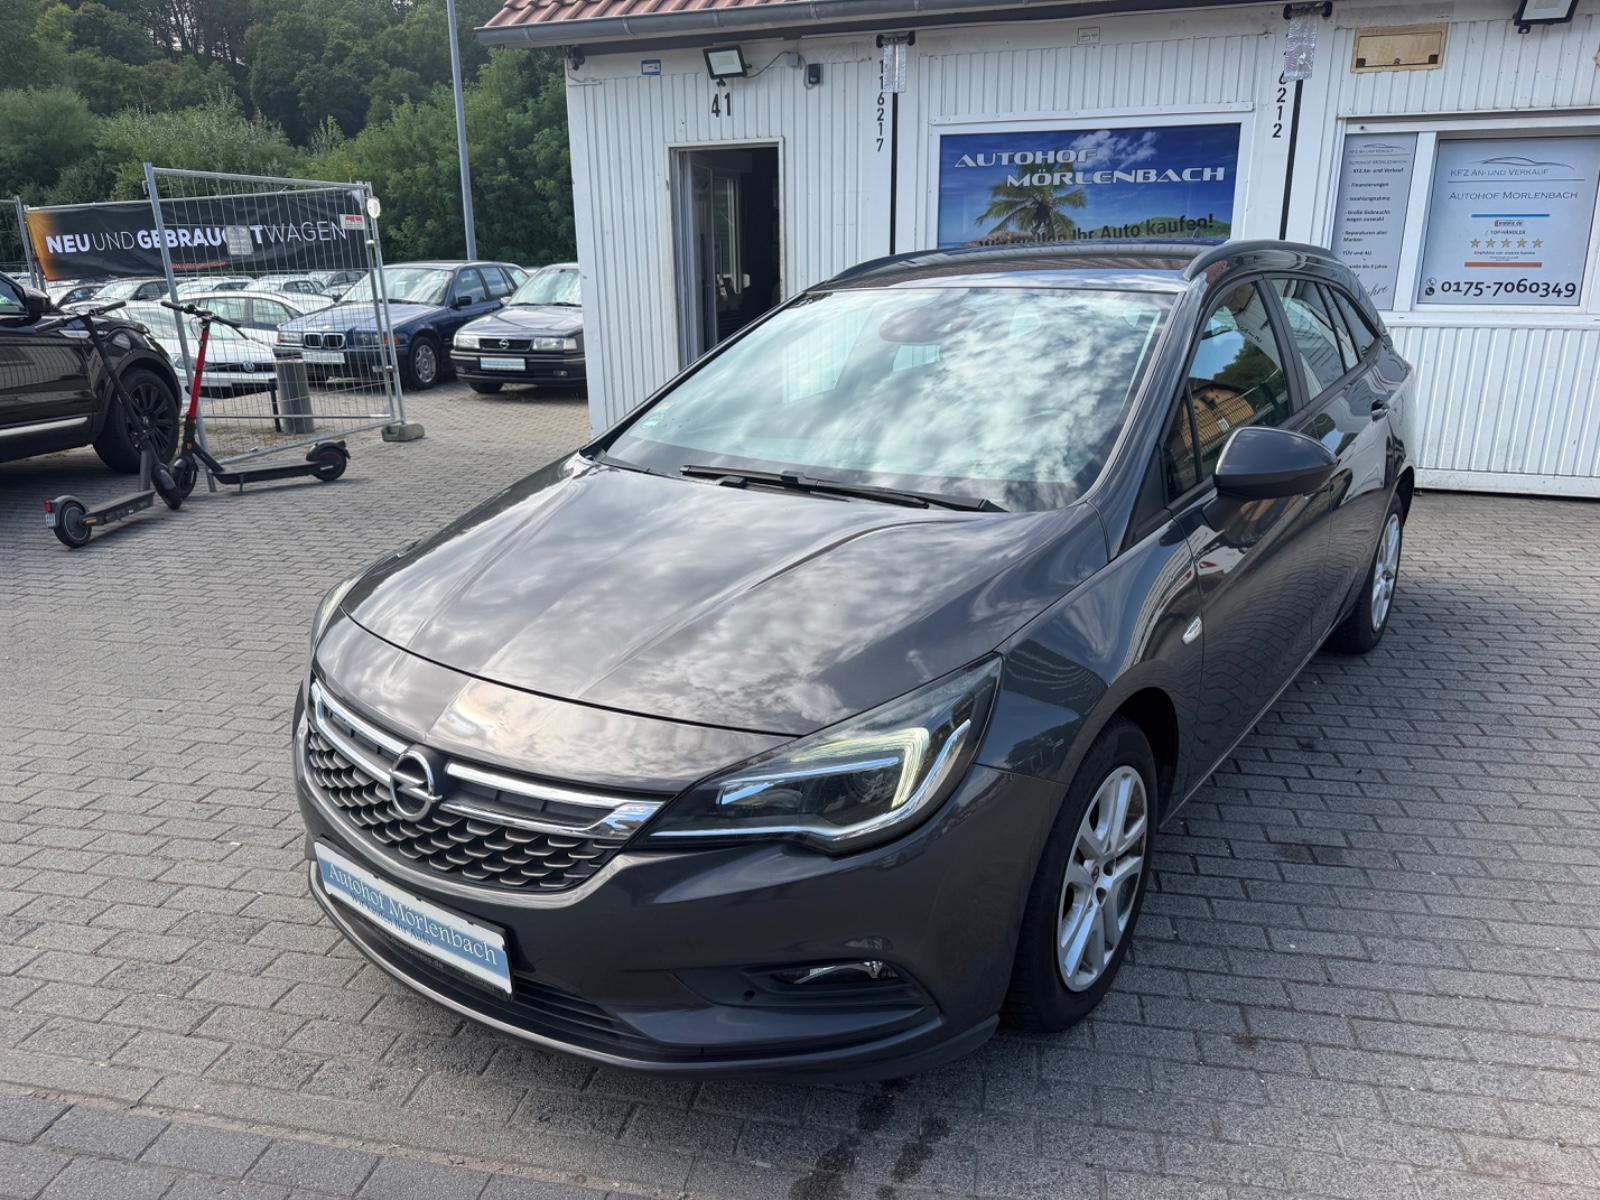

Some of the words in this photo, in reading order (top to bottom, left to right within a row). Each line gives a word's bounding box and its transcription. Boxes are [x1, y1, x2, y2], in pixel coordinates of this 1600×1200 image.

[711, 92, 731, 118] 41
[955, 149, 1097, 168] AUTOHOF
[1006, 167, 1225, 188] MÖRLENBACH
[1450, 169, 1469, 177] KFZ
[1508, 168, 1550, 176] VERKAUF
[1449, 191, 1501, 200] AUTOHOF
[1100, 223, 1141, 239] Auto
[1146, 213, 1214, 236] kaufen!
[1440, 278, 1577, 298] 0175-7060349
[329, 863, 385, 910] Autohof
[389, 896, 498, 966] Mörlenbach
